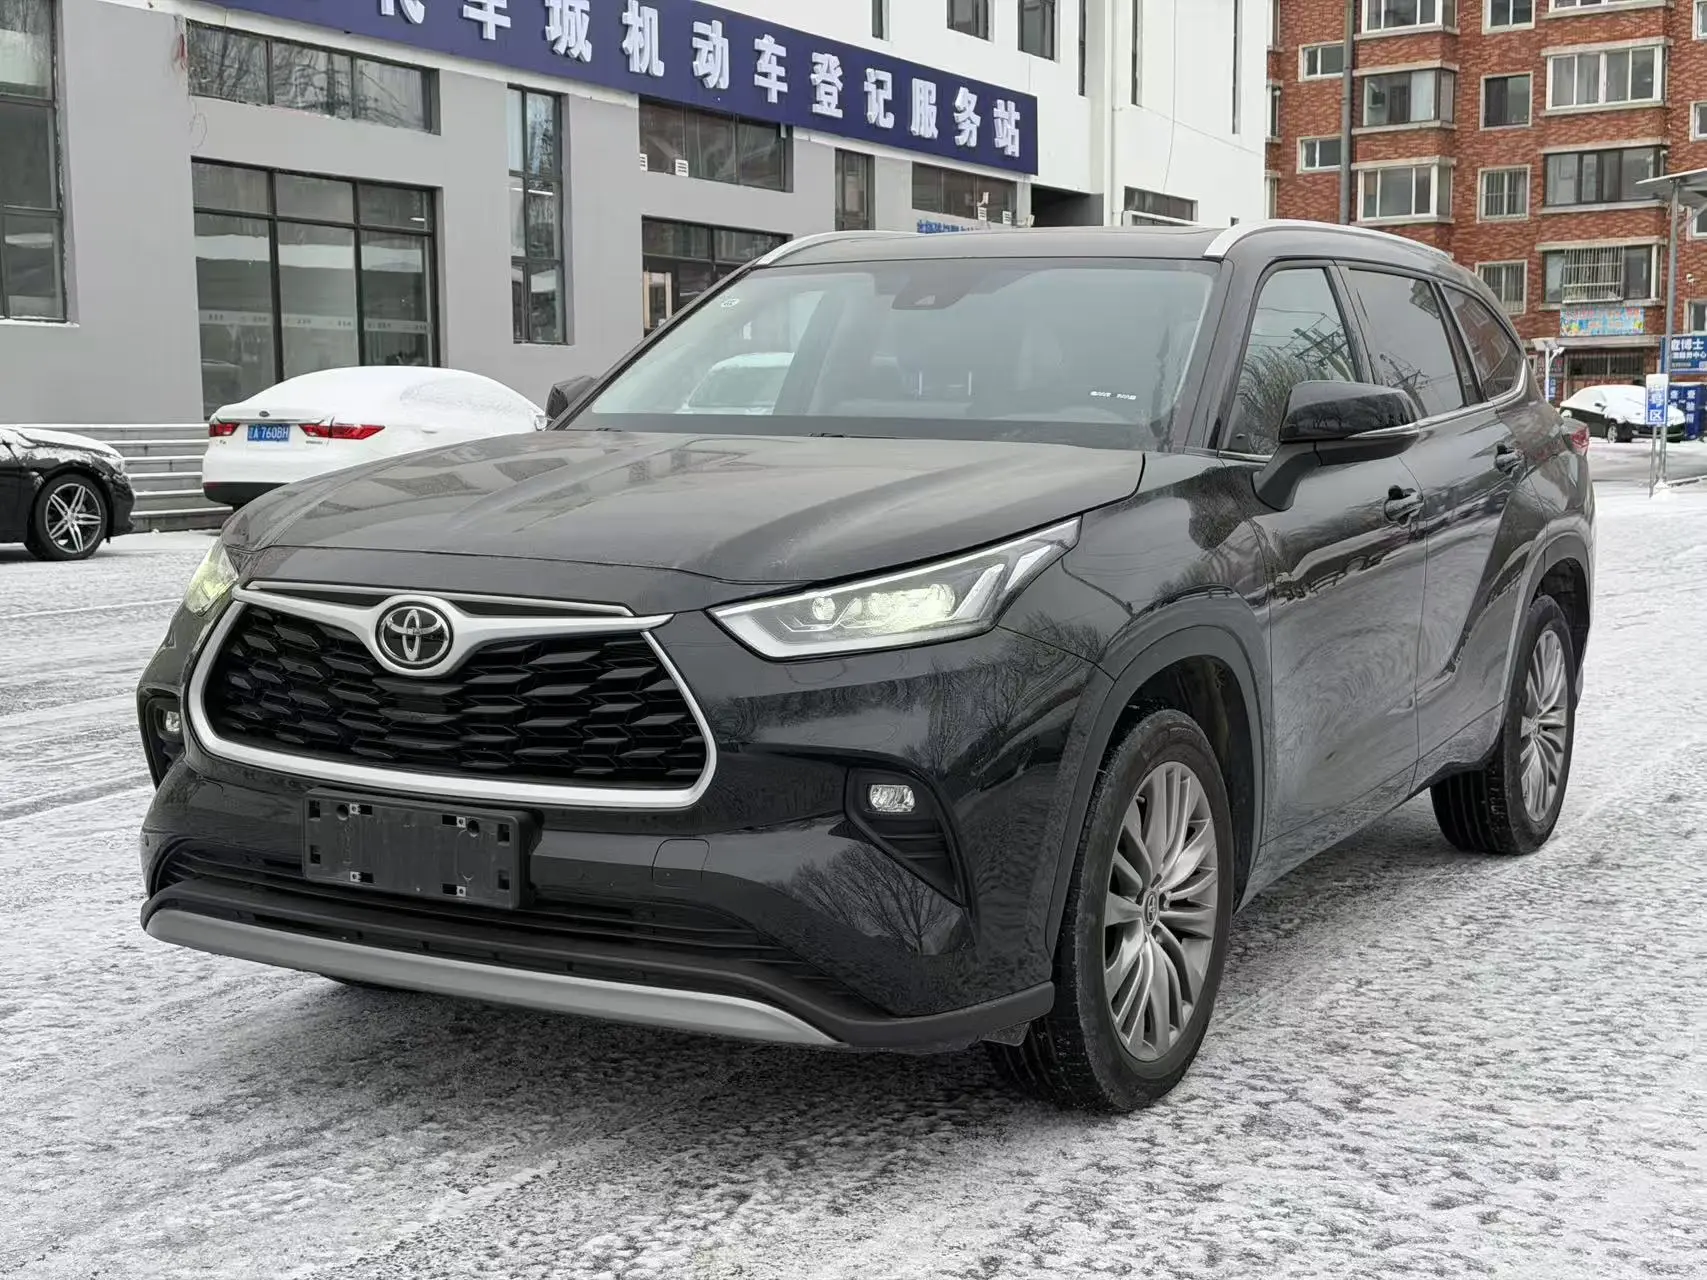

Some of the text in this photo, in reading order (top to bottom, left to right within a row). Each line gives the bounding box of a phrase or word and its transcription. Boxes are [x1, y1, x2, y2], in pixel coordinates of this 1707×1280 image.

[380, 0, 1021, 157] 车城机动车登记服务站
